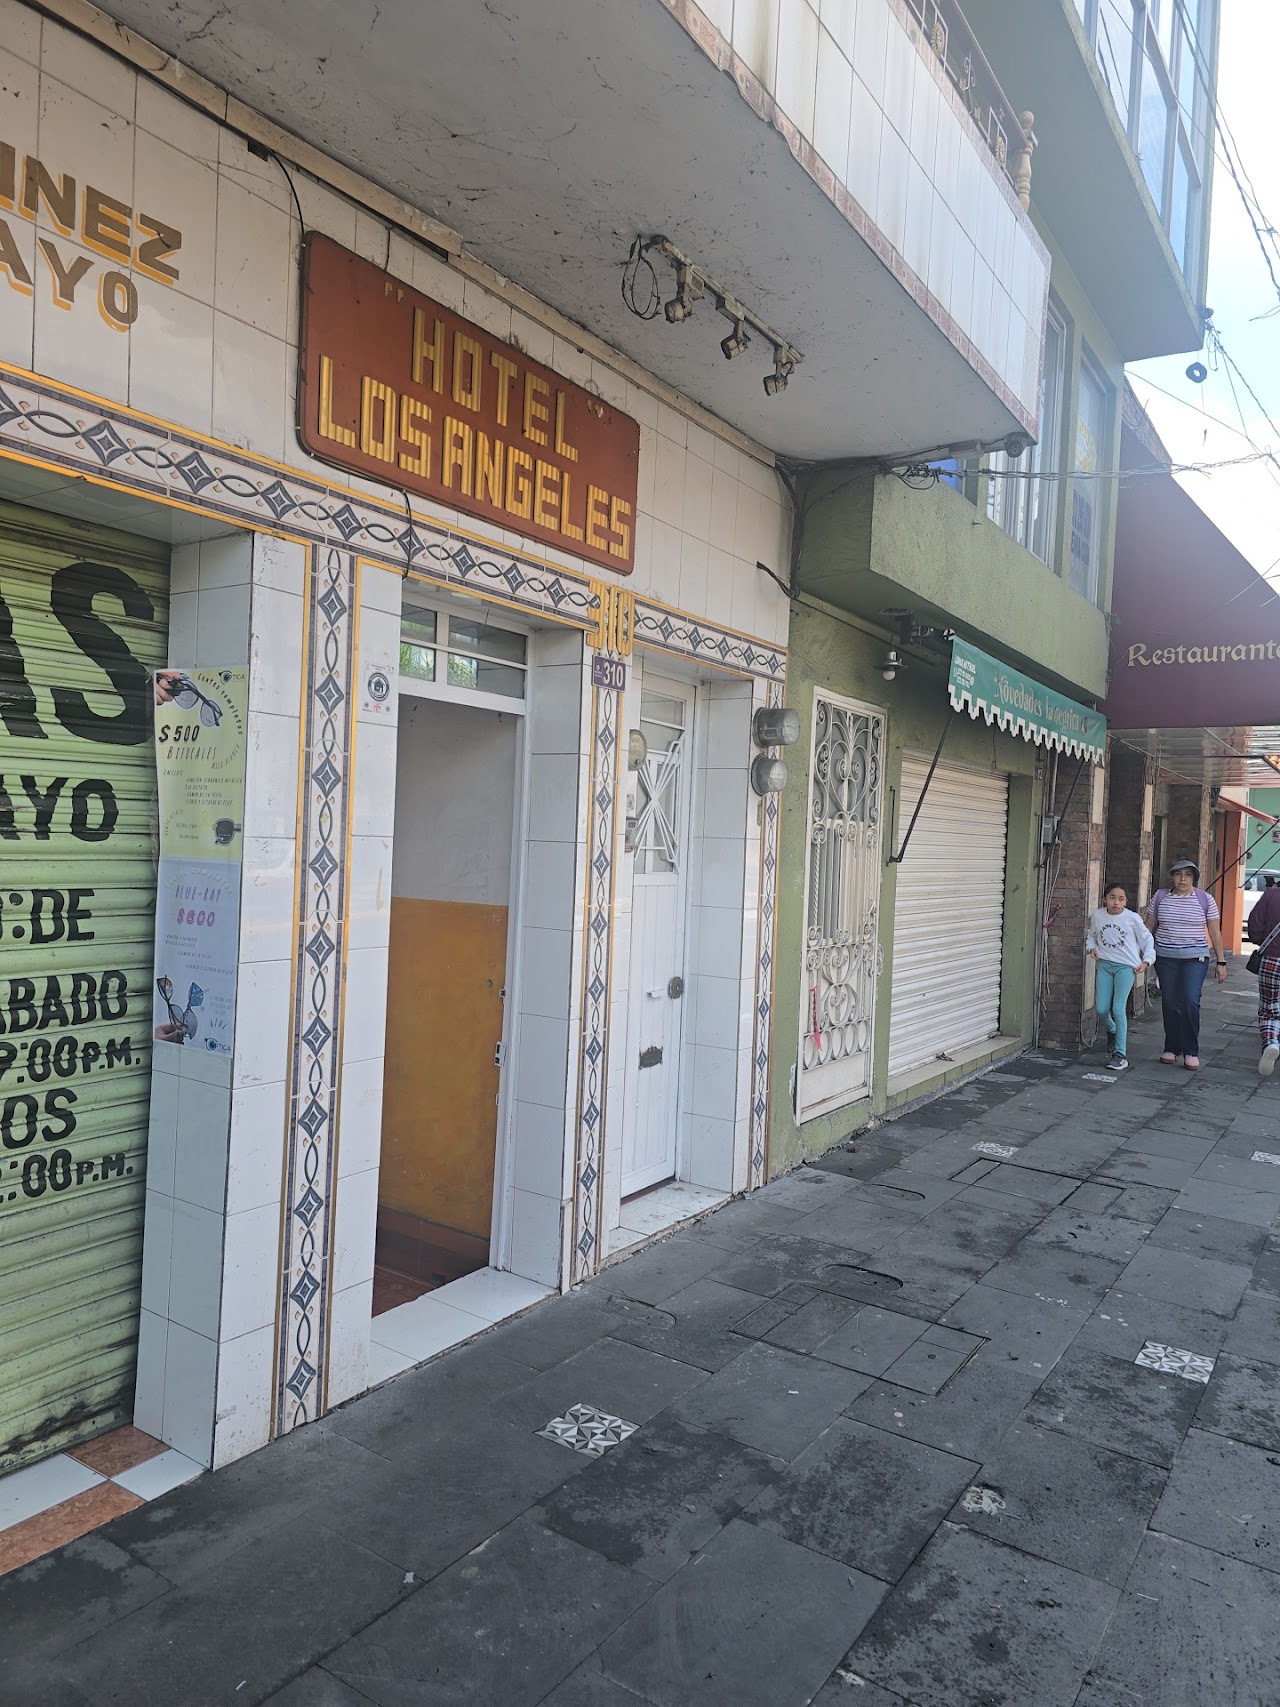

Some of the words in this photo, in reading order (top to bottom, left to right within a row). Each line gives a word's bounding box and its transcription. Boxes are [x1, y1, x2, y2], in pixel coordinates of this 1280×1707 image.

[411, 305, 579, 463] HOTEL
[318, 353, 432, 479] LOS
[441, 415, 631, 560] ANGELES
[586, 579, 635, 657] 310
[603, 661, 624, 688] 310
[177, 907, 216, 928] $600
[0, 970, 128, 1034] BADO
